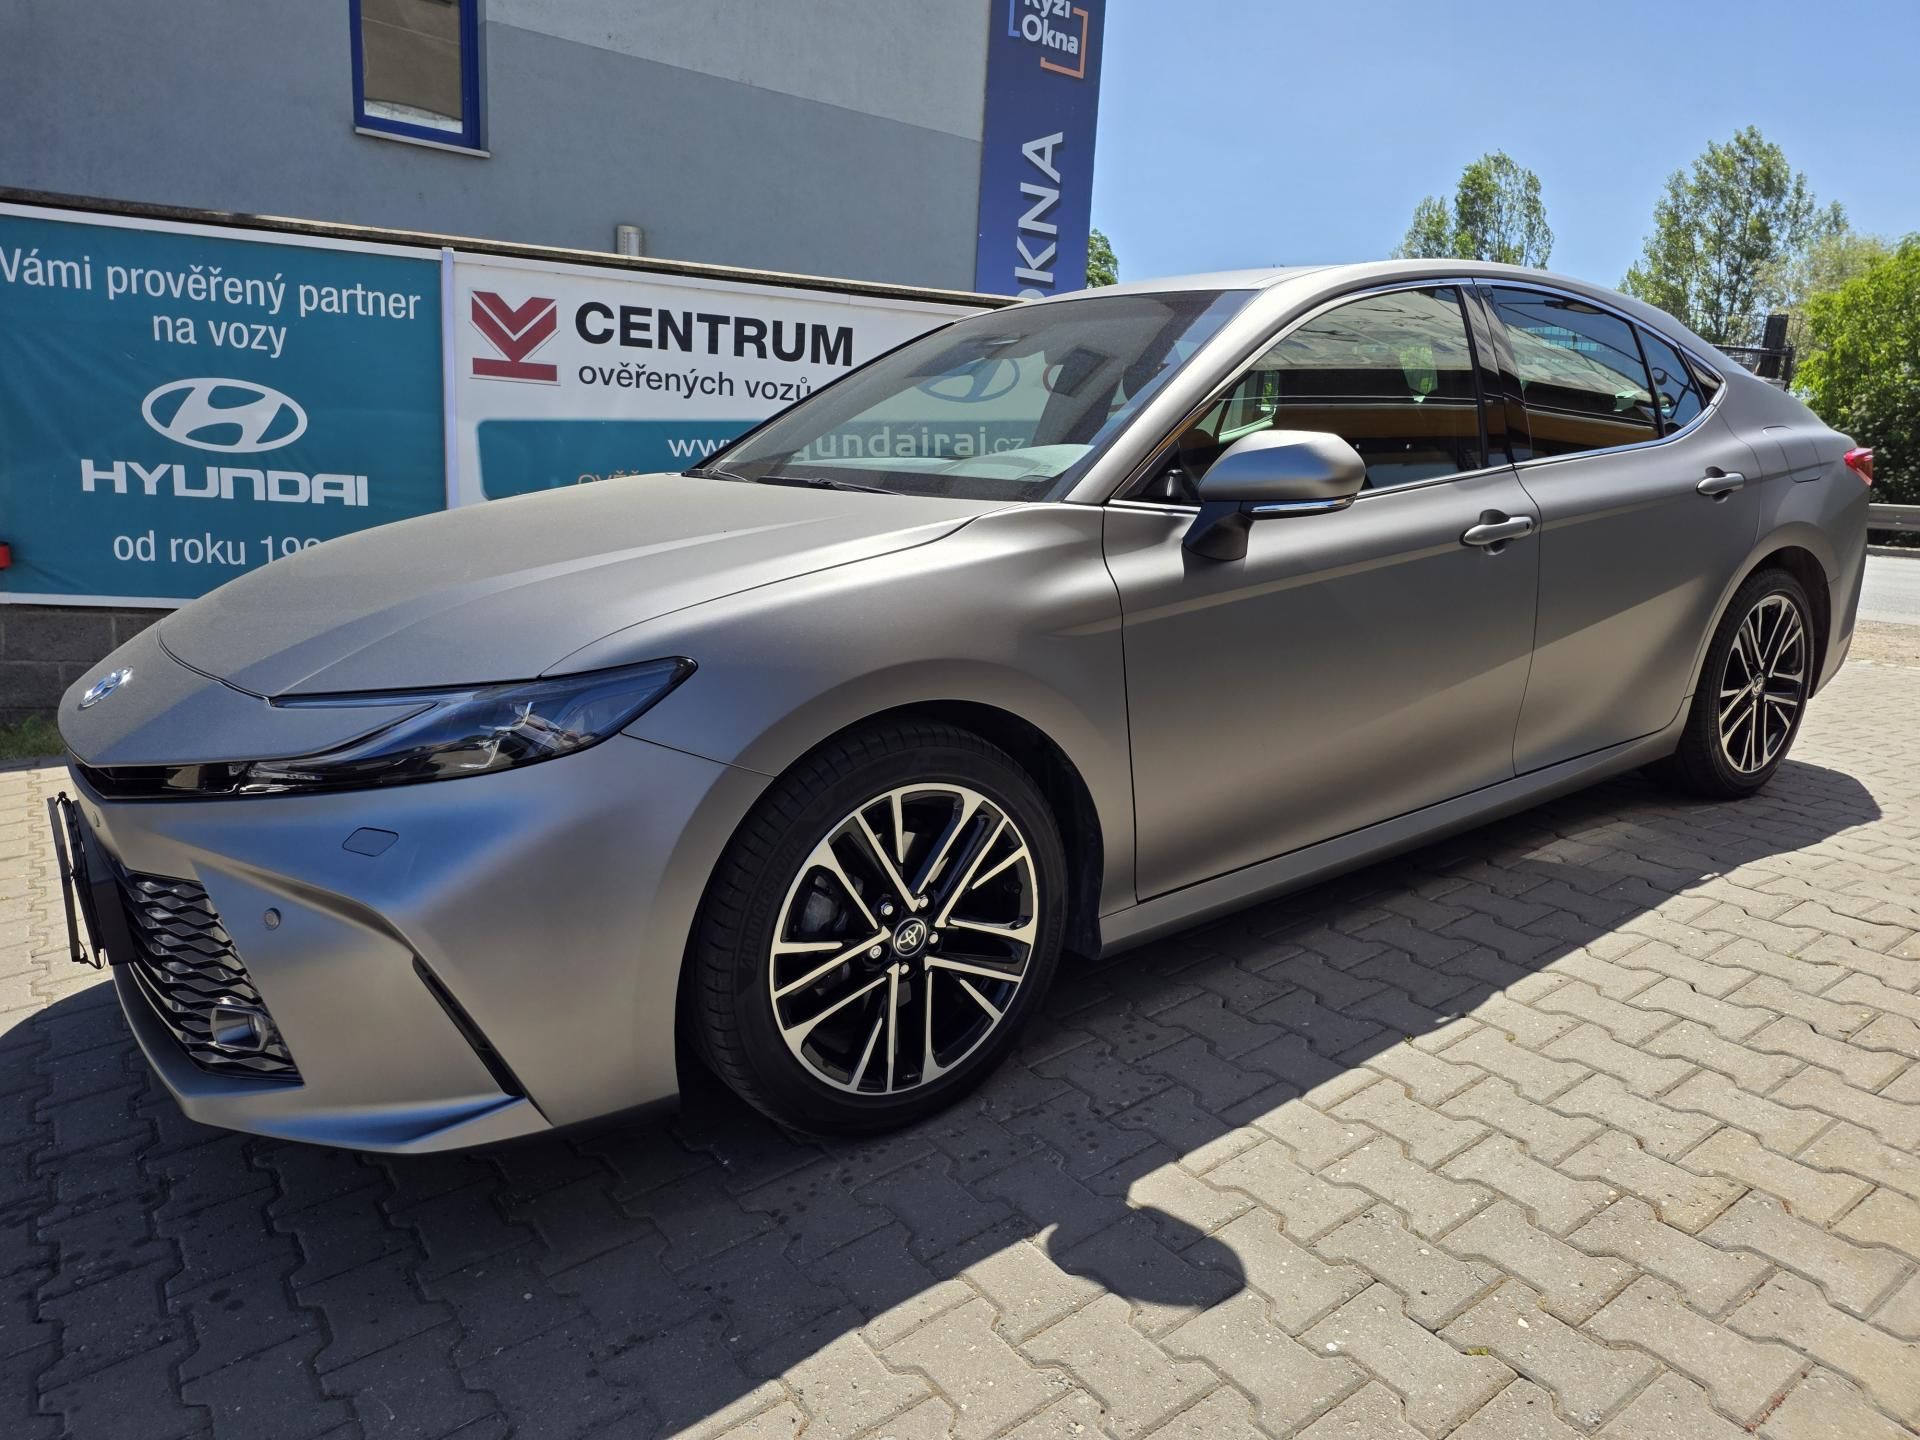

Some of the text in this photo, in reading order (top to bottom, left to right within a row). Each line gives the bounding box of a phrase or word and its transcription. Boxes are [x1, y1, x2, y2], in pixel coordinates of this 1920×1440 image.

[1022, 14, 1079, 55] Okna
[1014, 131, 1064, 300] KNA
[0, 246, 421, 319] Vámi prověřený partner
[153, 314, 287, 358] na vozy
[575, 301, 853, 367] CENTRUM
[578, 361, 734, 400] ověřených
[81, 458, 369, 506] HYUNDAI
[113, 530, 156, 562] od
[170, 532, 246, 566] roku
